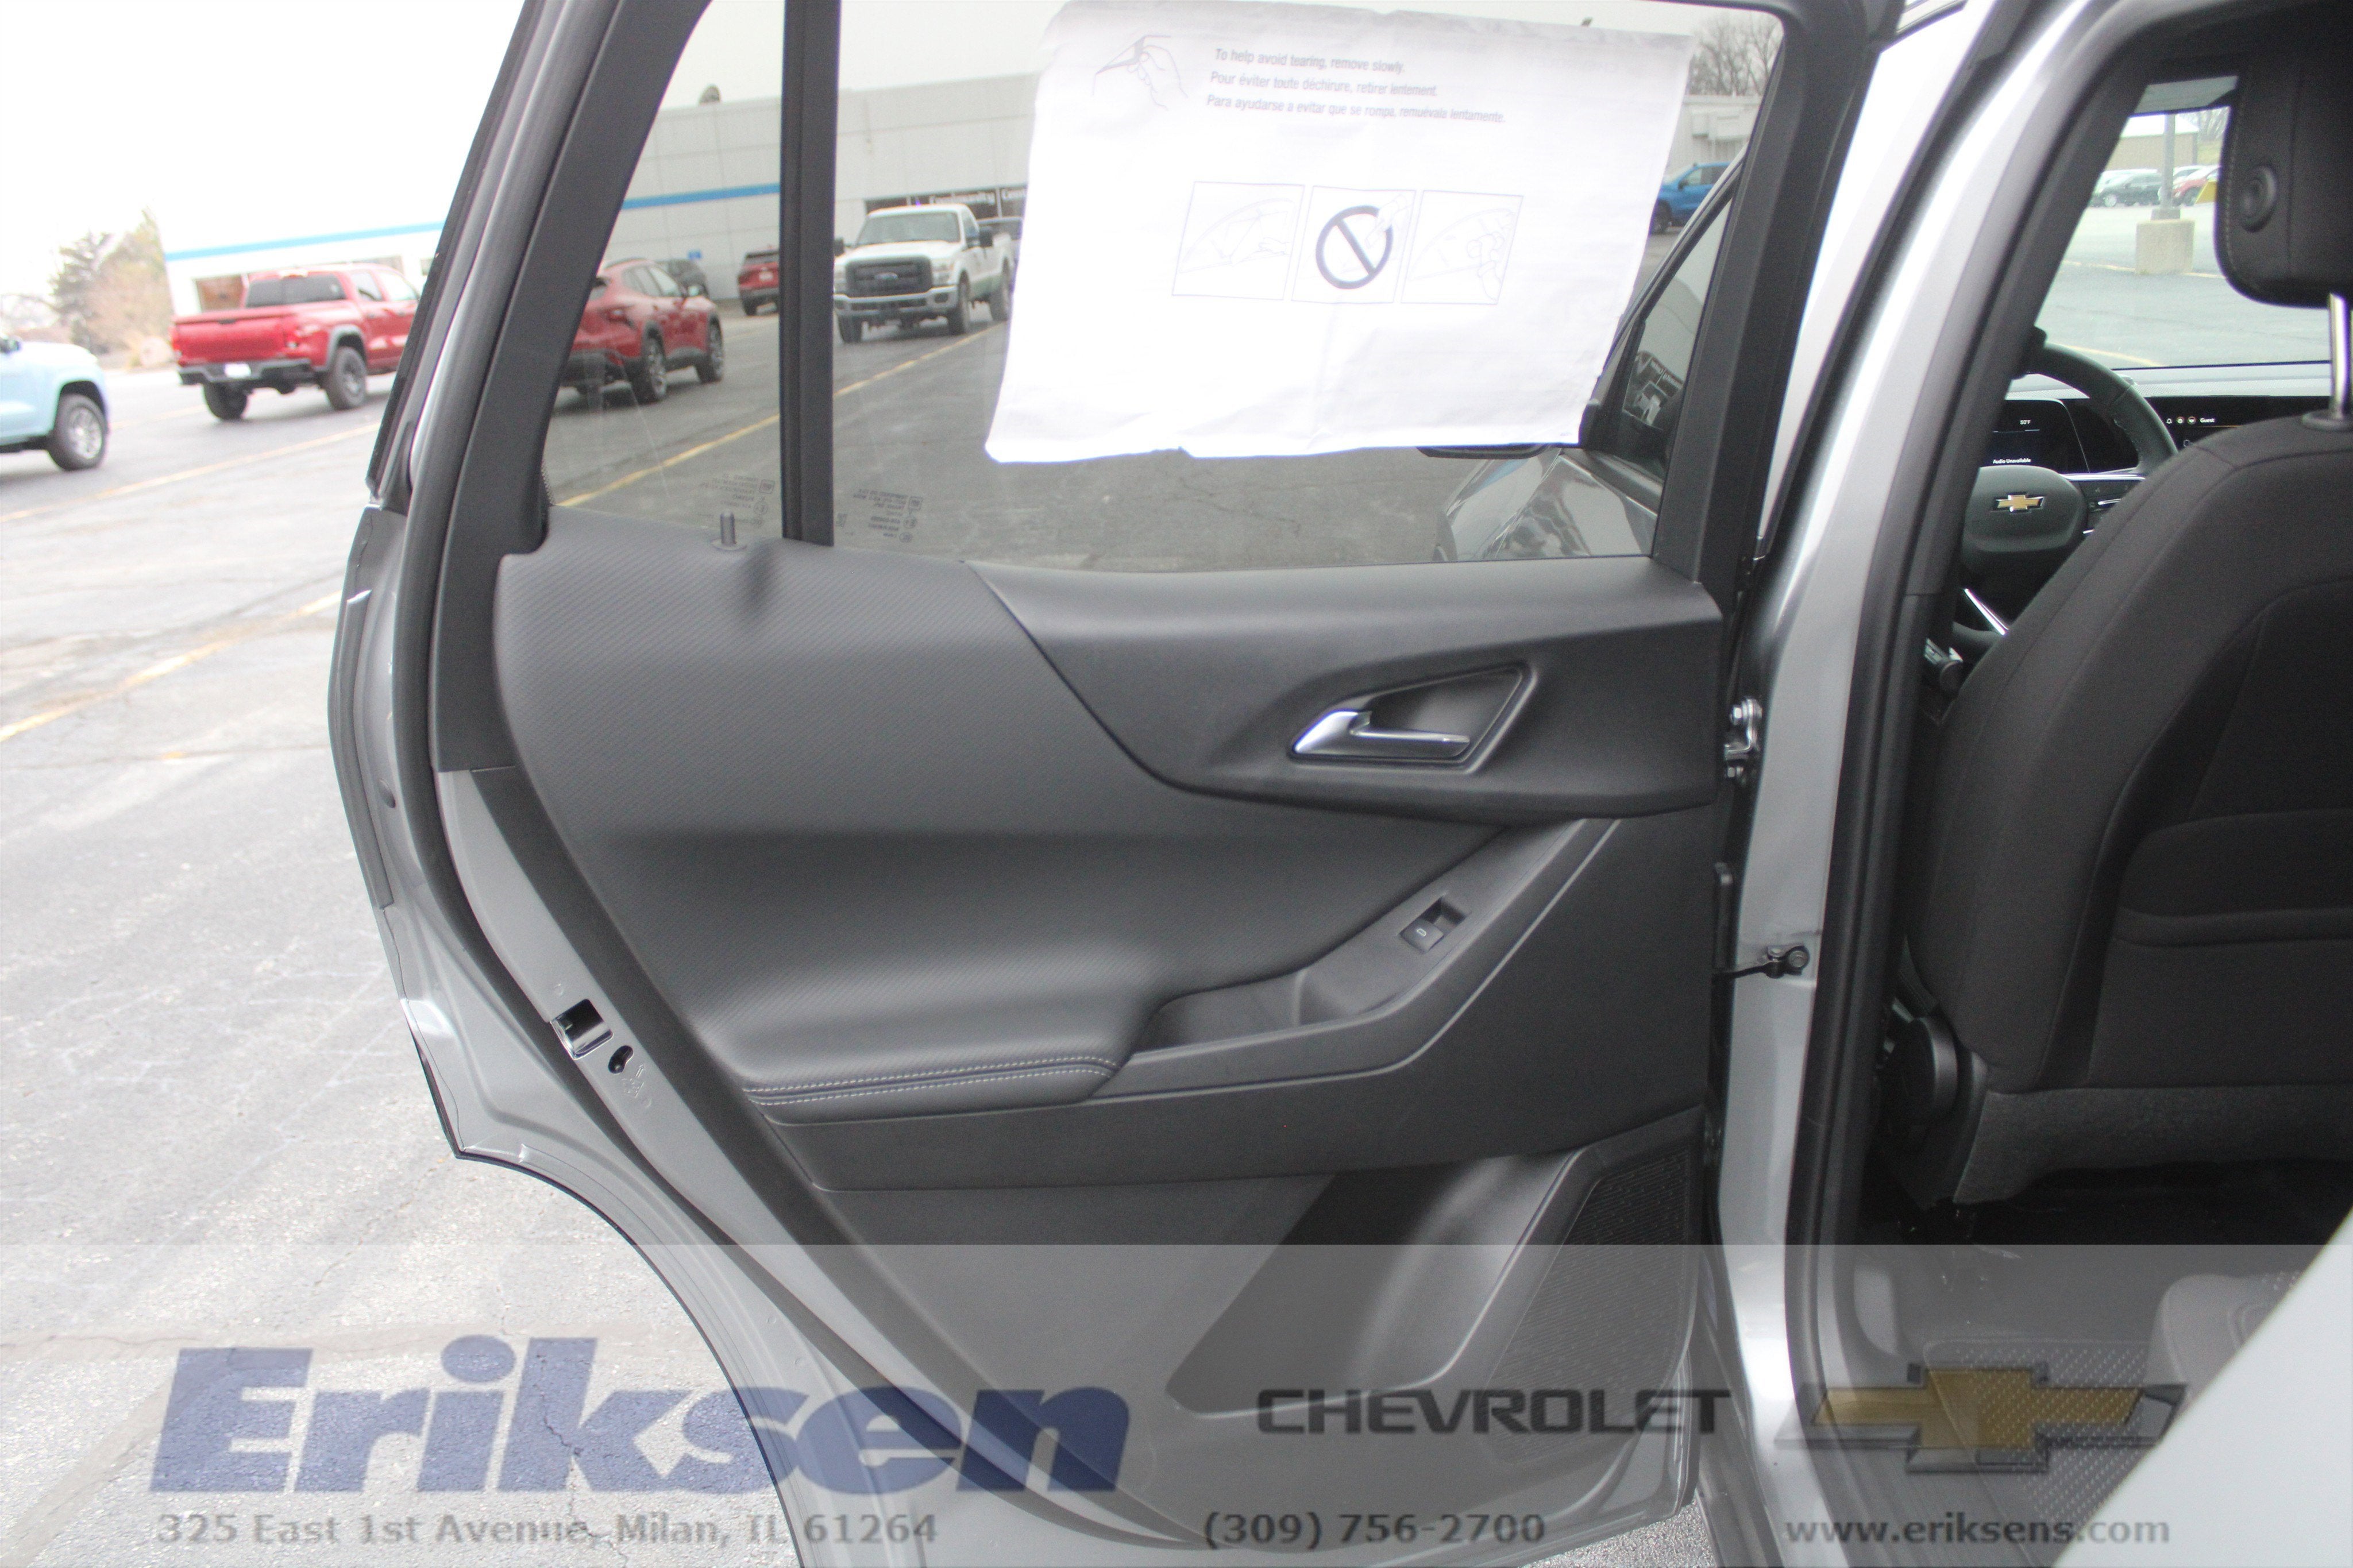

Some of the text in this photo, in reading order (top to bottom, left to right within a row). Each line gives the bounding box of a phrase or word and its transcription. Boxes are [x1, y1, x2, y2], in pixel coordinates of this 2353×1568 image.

[1215, 48, 1406, 75] To help avoid tearing, remove slowly.
[1210, 71, 1438, 96] Pour éviter toute déchirure, retirer lentement.
[1207, 94, 1232, 107] Para
[1235, 98, 1285, 111] ayudarse
[1287, 102, 1294, 113] a
[1297, 101, 1326, 114] evitar
[1328, 105, 1347, 116] que
[1349, 106, 1362, 117] se
[1365, 106, 1397, 118] rompa,
[1449, 108, 1506, 123] lentamente.
